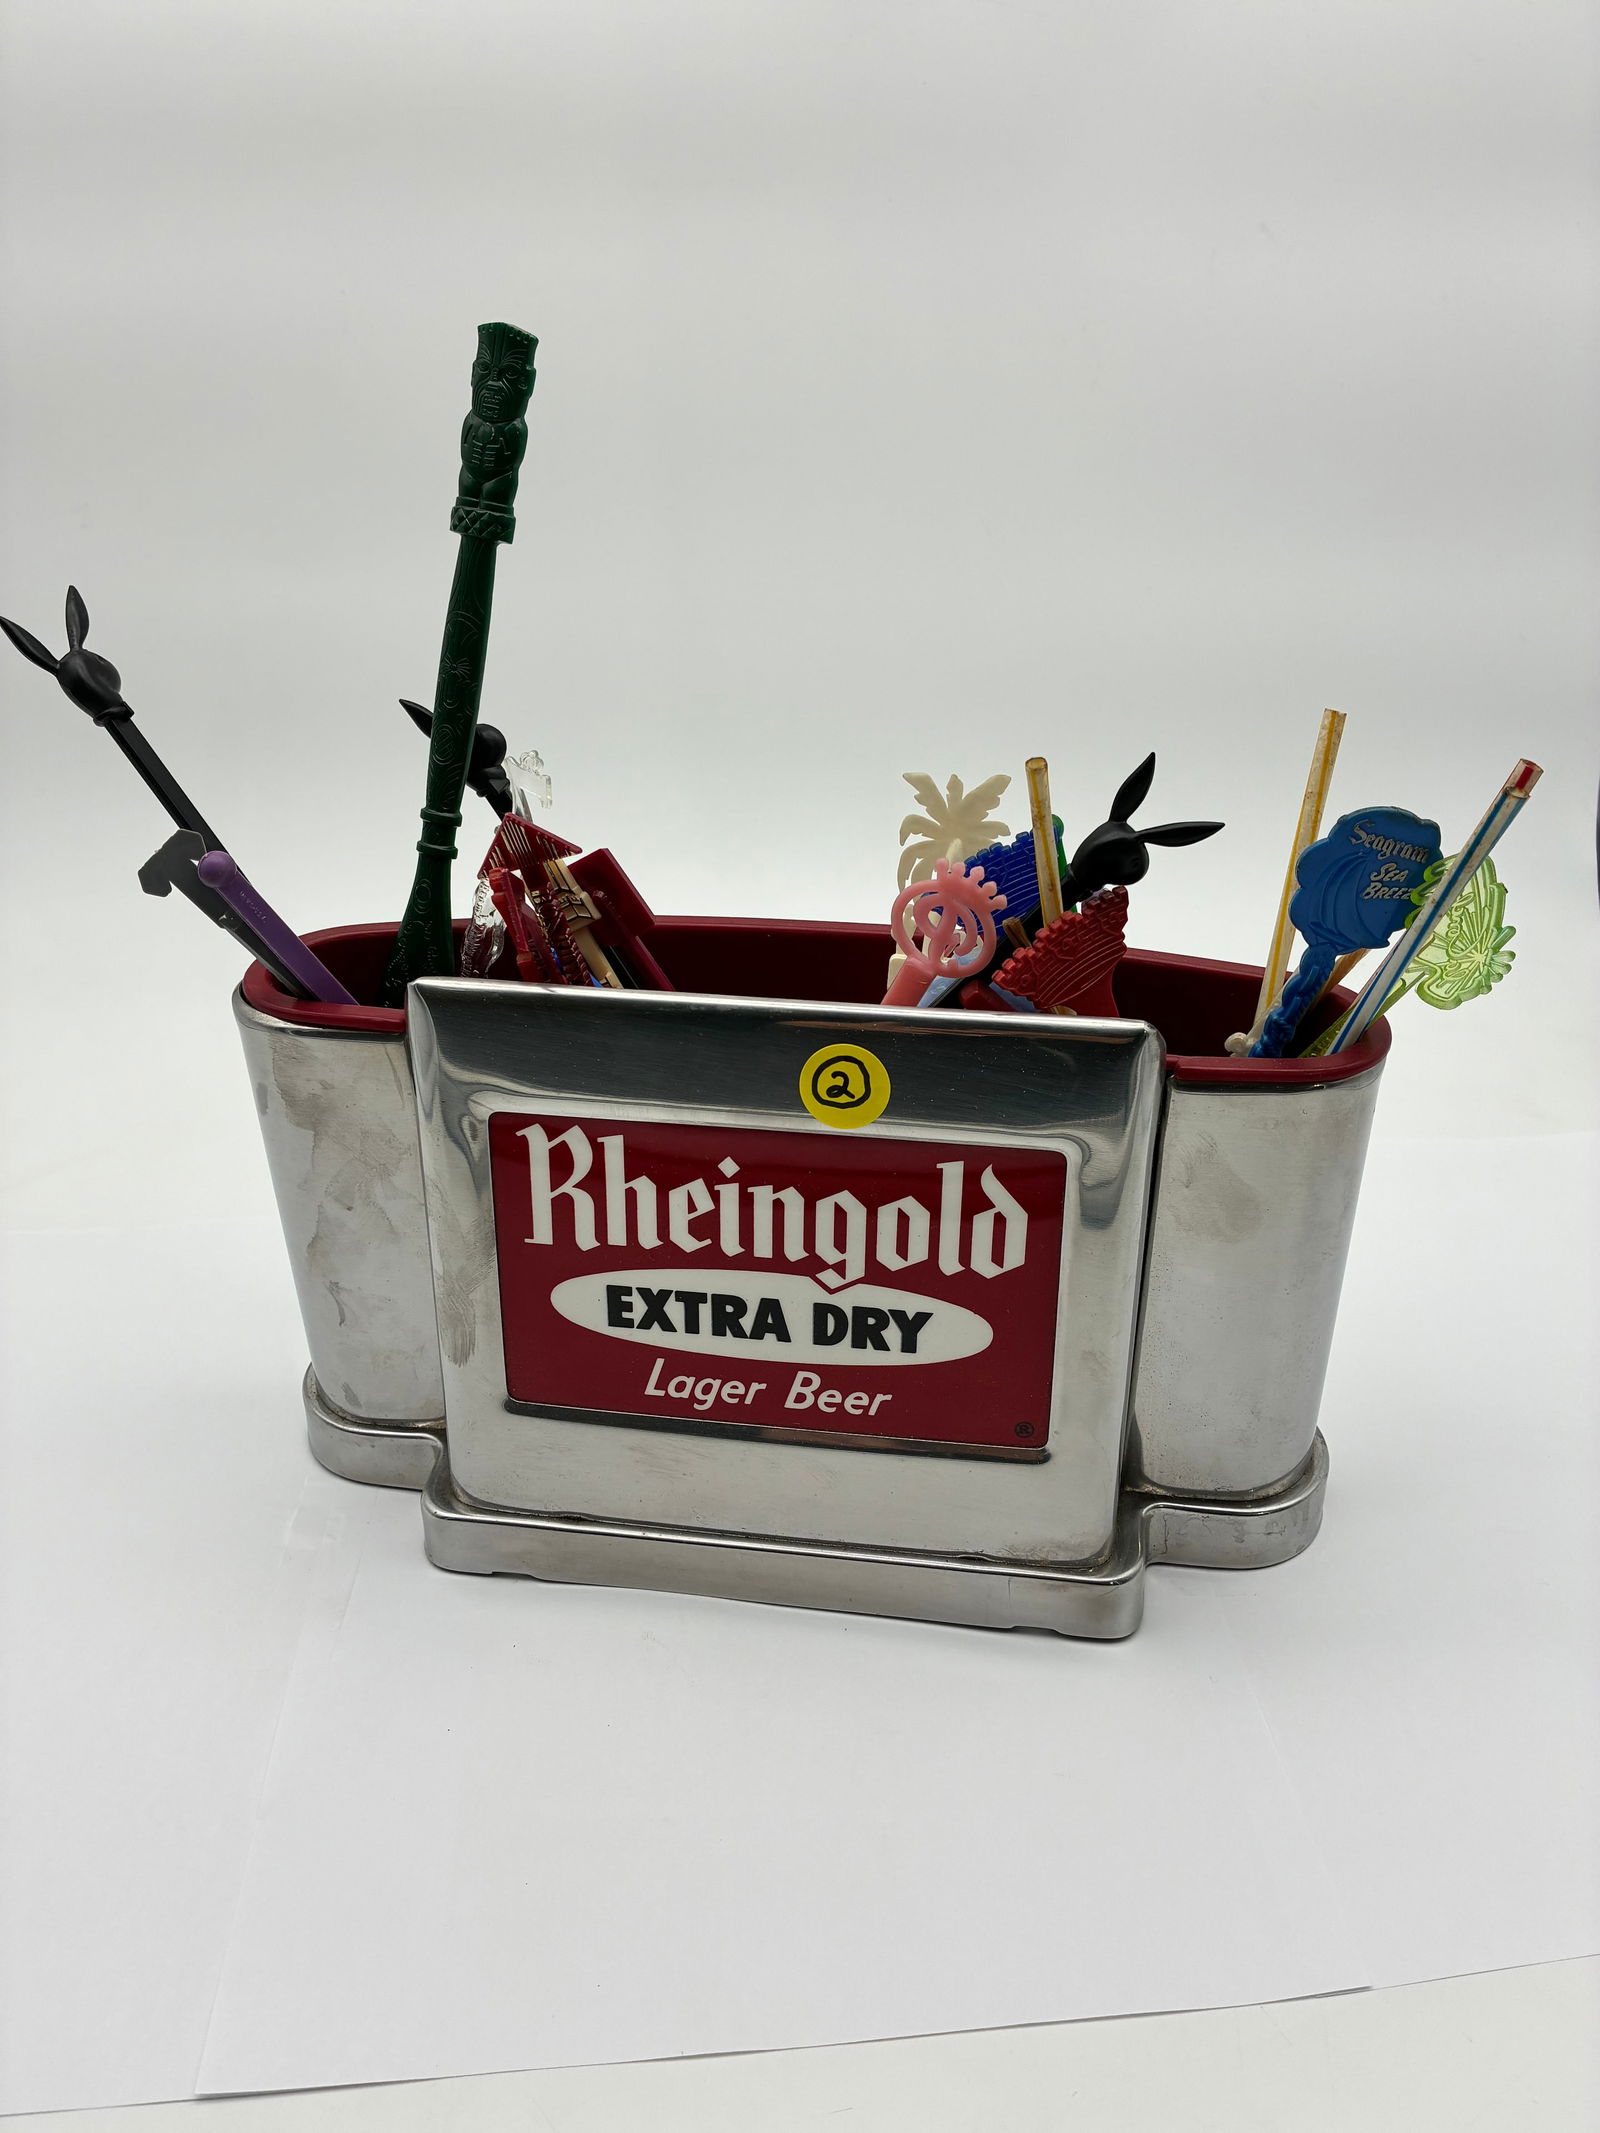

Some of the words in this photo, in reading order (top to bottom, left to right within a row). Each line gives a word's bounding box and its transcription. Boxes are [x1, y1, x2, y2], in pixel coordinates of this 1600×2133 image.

[1348, 819, 1429, 864] Seagram
[1362, 881, 1417, 900] BREEZ
[1370, 862, 1409, 882] SEA
[825, 1070, 856, 1100] 2
[515, 1122, 1029, 1290] Rheingold
[605, 1284, 792, 1344] EXTRA
[812, 1302, 934, 1354] DRY
[643, 1357, 768, 1411] Lager
[783, 1370, 893, 1416] Beer
